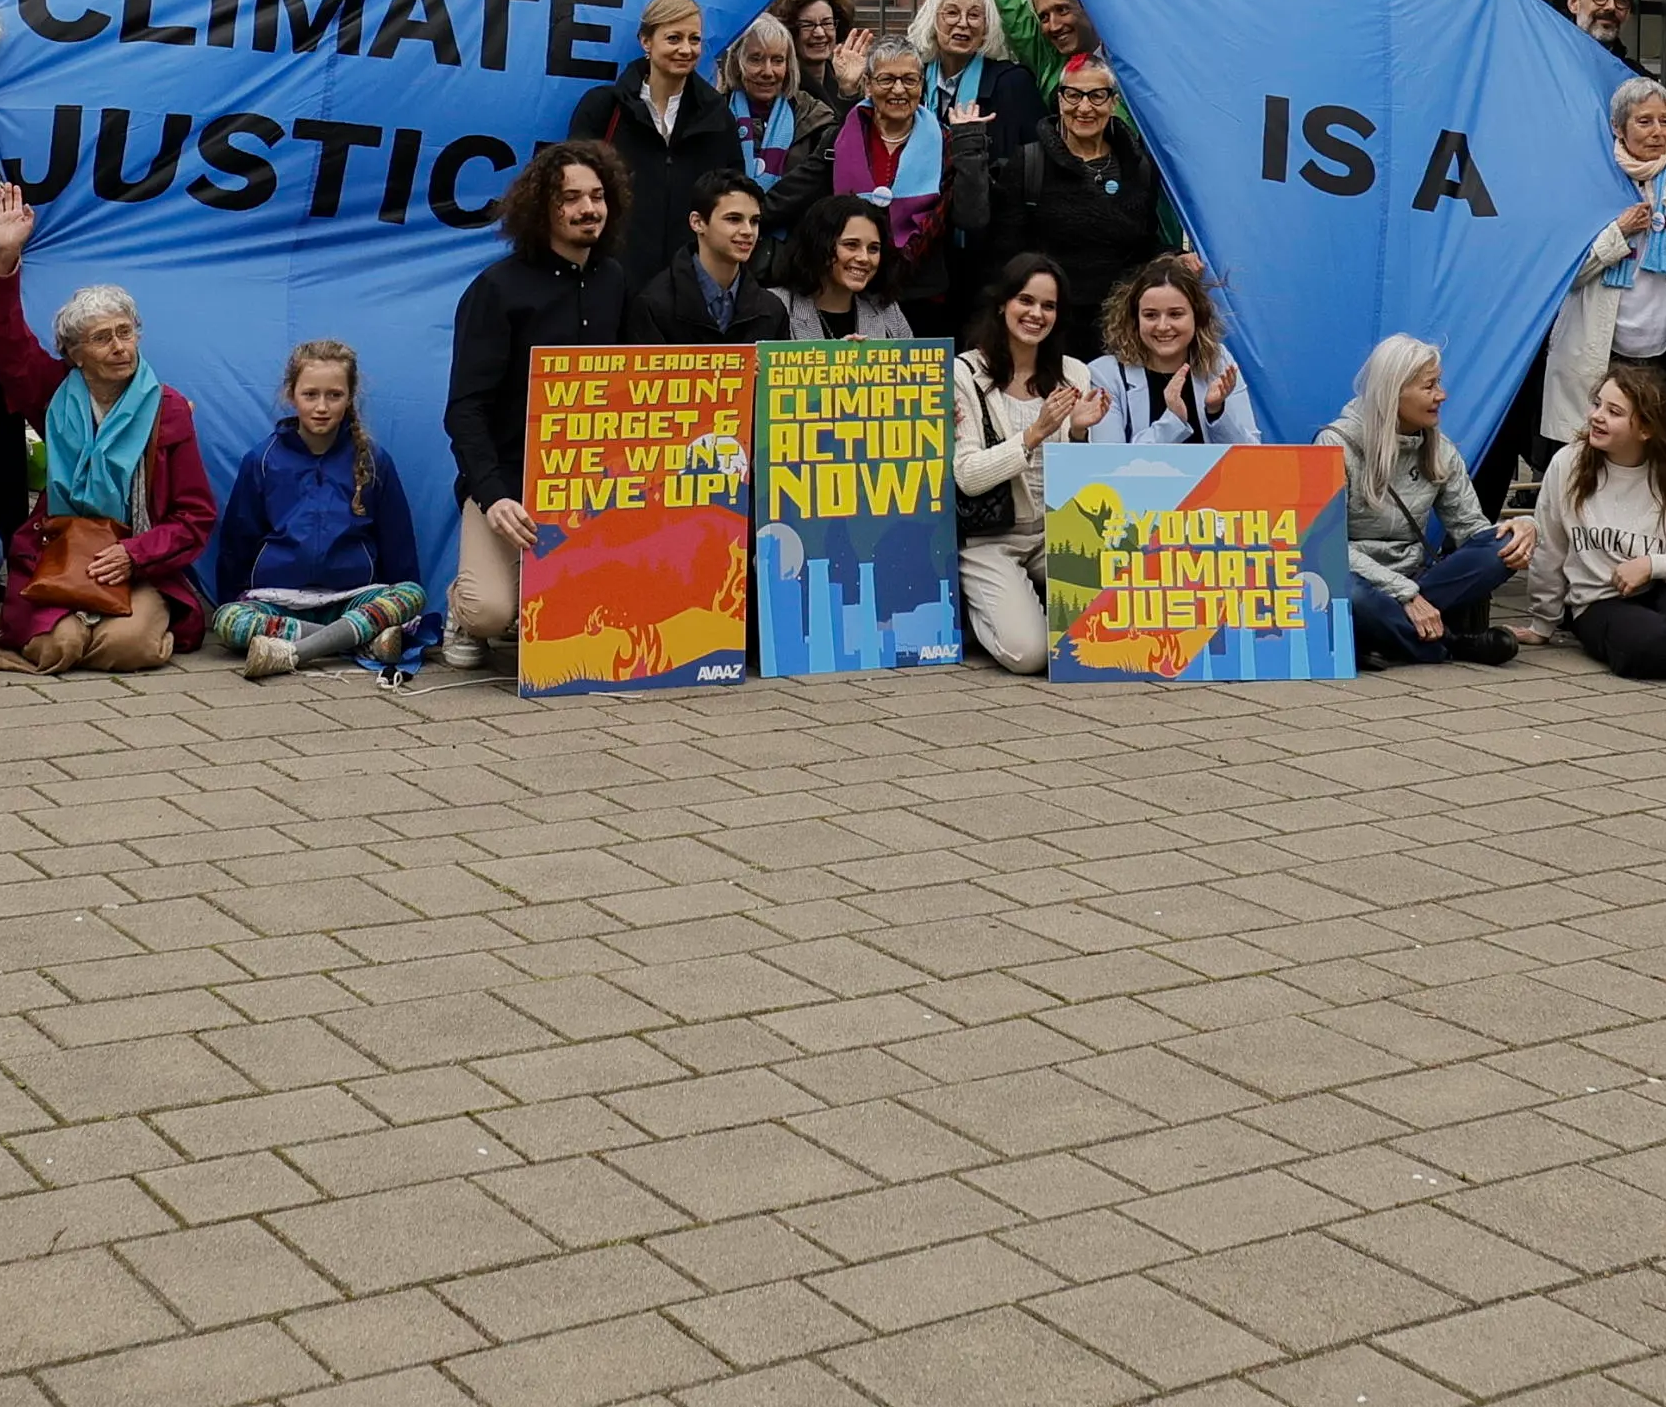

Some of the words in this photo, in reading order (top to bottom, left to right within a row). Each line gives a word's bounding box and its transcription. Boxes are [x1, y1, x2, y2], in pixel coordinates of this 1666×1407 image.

[2, 105, 569, 229] JUSTIC
[1261, 94, 1378, 197] IS
[1411, 129, 1498, 217] A
[541, 355, 570, 373] TO
[578, 354, 626, 372] OUR
[634, 353, 745, 371] LEADERS:
[768, 347, 826, 365] TIME'S
[835, 349, 858, 364] UP
[867, 349, 901, 363] FOR
[909, 348, 945, 363] OUR
[768, 363, 945, 386] GOVERNMENTS:
[544, 380, 610, 407] WE
[629, 370, 743, 405] WON'T
[769, 385, 945, 420] CLIMATE
[540, 410, 699, 441] FORGET
[713, 409, 740, 438] &
[769, 419, 944, 463] ACTION
[540, 447, 605, 474] WE
[536, 476, 646, 512] GIVE
[664, 473, 740, 508] UP!
[769, 459, 944, 521] NOW!
[1102, 509, 1298, 548] #YOUTH4
[1100, 550, 1305, 588] CLIMATE
[1101, 588, 1306, 629] JUSTICE
[919, 643, 960, 660] AVAAZ
[697, 663, 743, 681] AVAAZ
